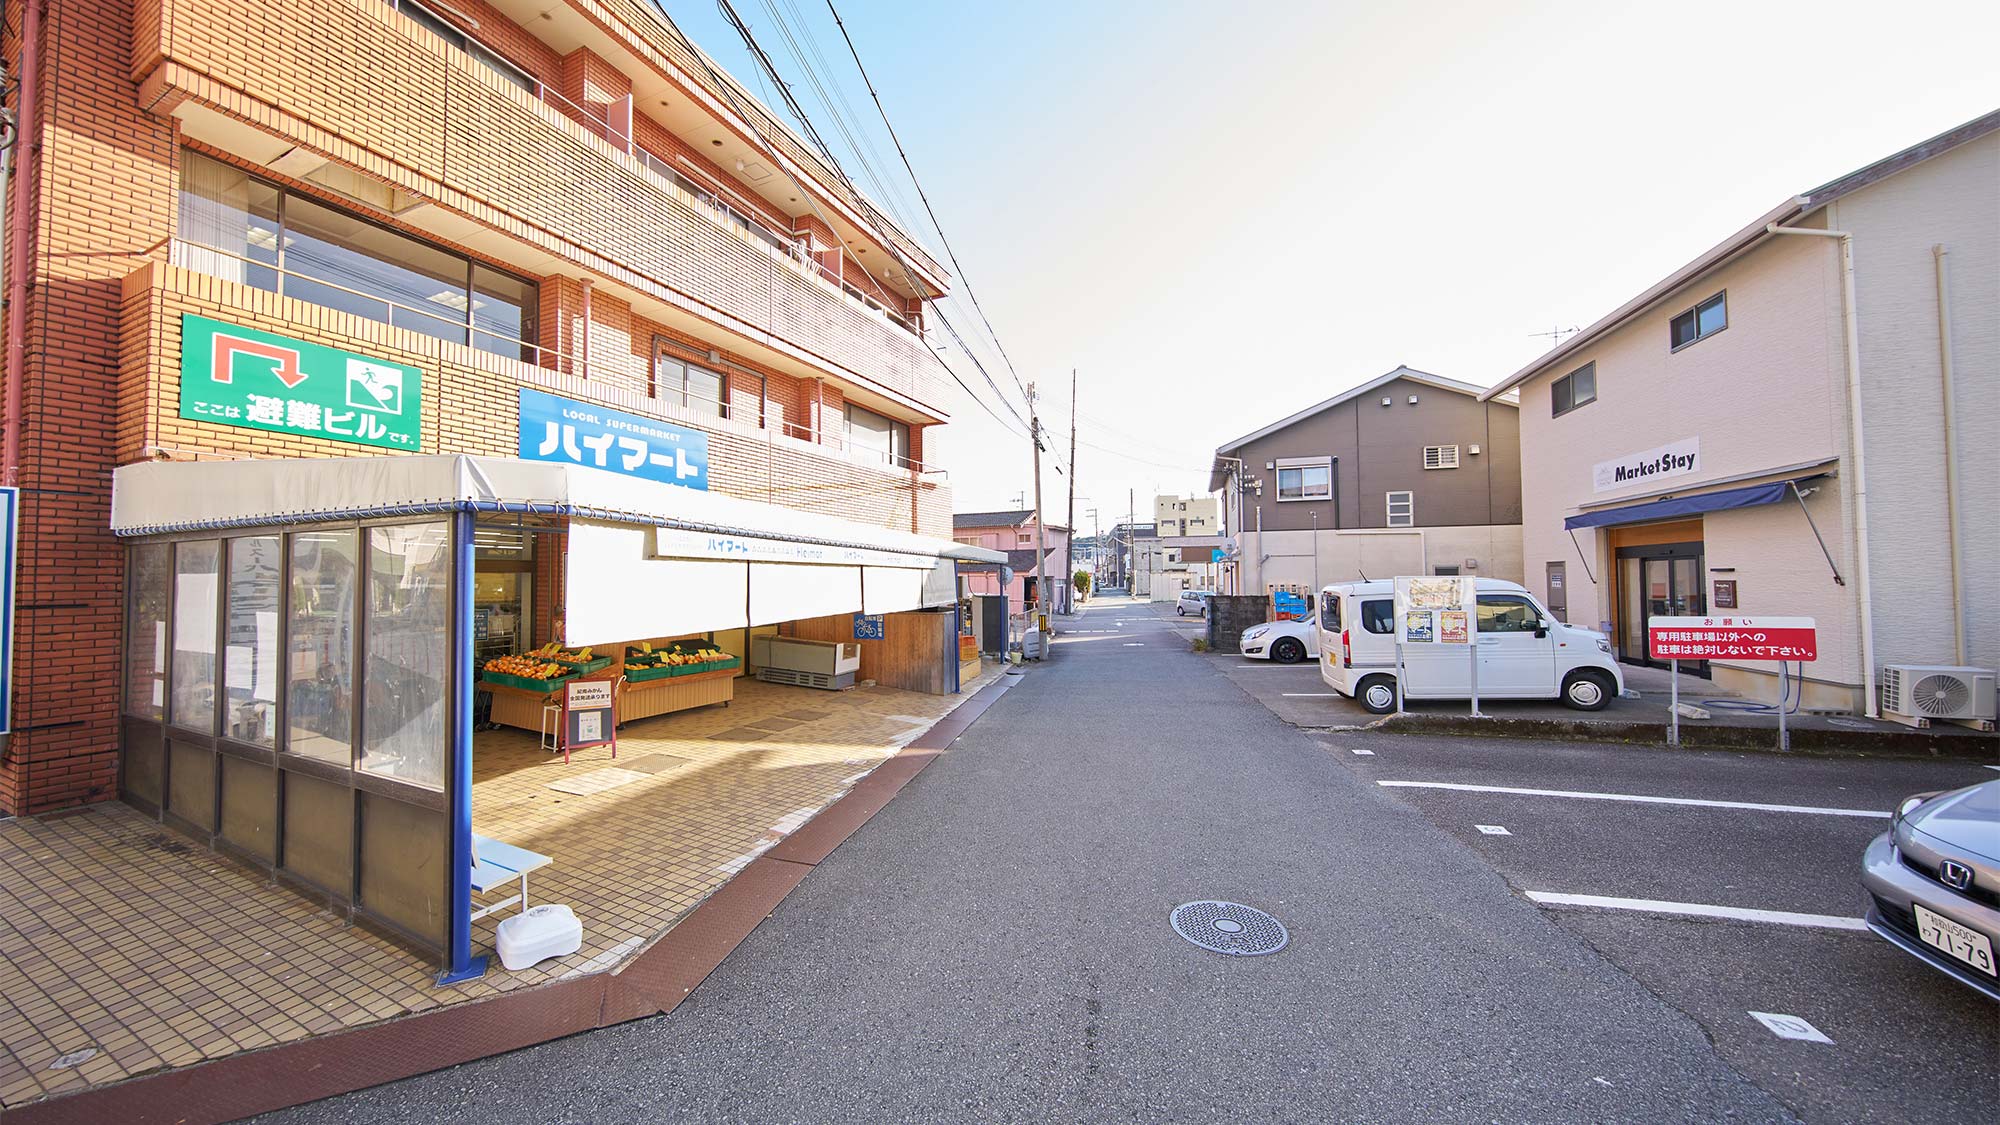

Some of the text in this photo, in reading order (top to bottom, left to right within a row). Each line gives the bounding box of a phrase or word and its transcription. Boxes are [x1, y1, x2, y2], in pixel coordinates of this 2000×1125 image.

[563, 408, 681, 443] LOCAL SUPERMARKET
[539, 421, 698, 480] ハイマート
[708, 538, 748, 553] ハイマート
[1704, 618, 1753, 626] お願い
[1656, 631, 1766, 642] 専用駐車場以外への
[1657, 644, 1813, 657] 駐車は絶対しないで下さい。
[1932, 926, 1990, 969] 71-79
